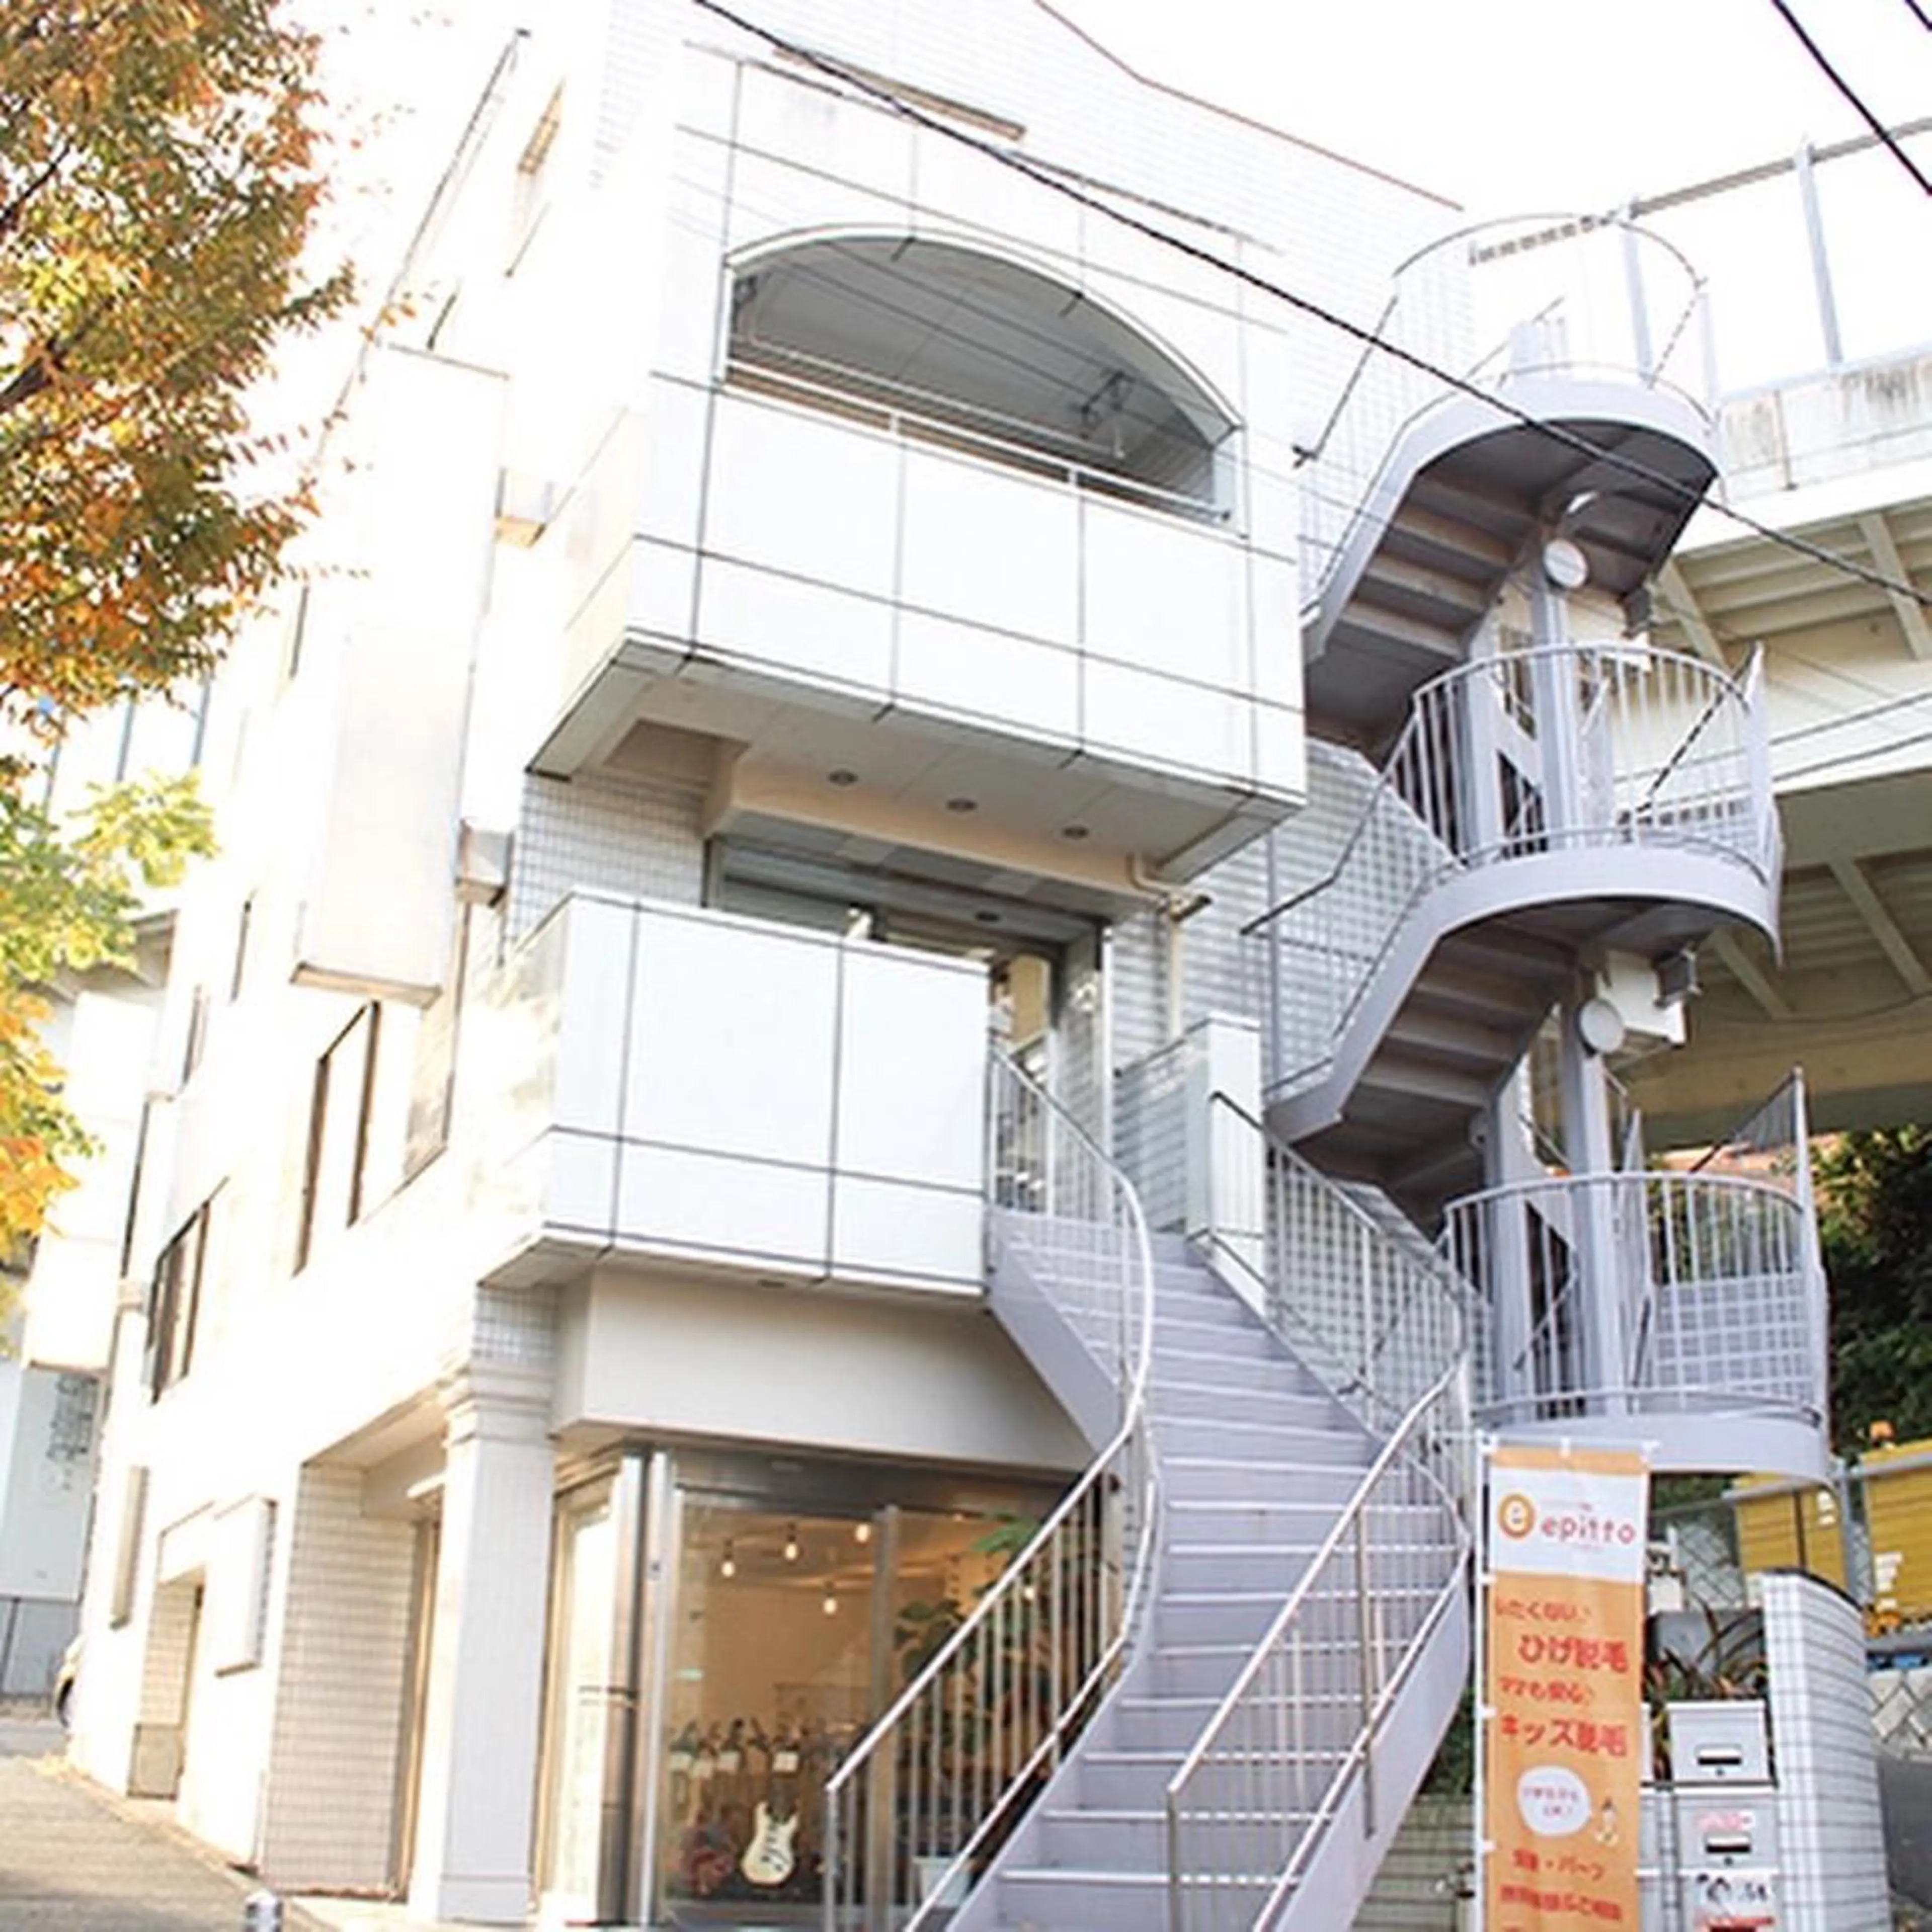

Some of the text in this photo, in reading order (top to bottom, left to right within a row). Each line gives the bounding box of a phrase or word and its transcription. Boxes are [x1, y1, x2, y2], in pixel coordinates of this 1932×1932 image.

[1542, 1515, 1636, 1544] epitto
[1518, 1634, 1628, 1674] ひげ脱毛
[1500, 1713, 1627, 1757] キッズ脱毛
